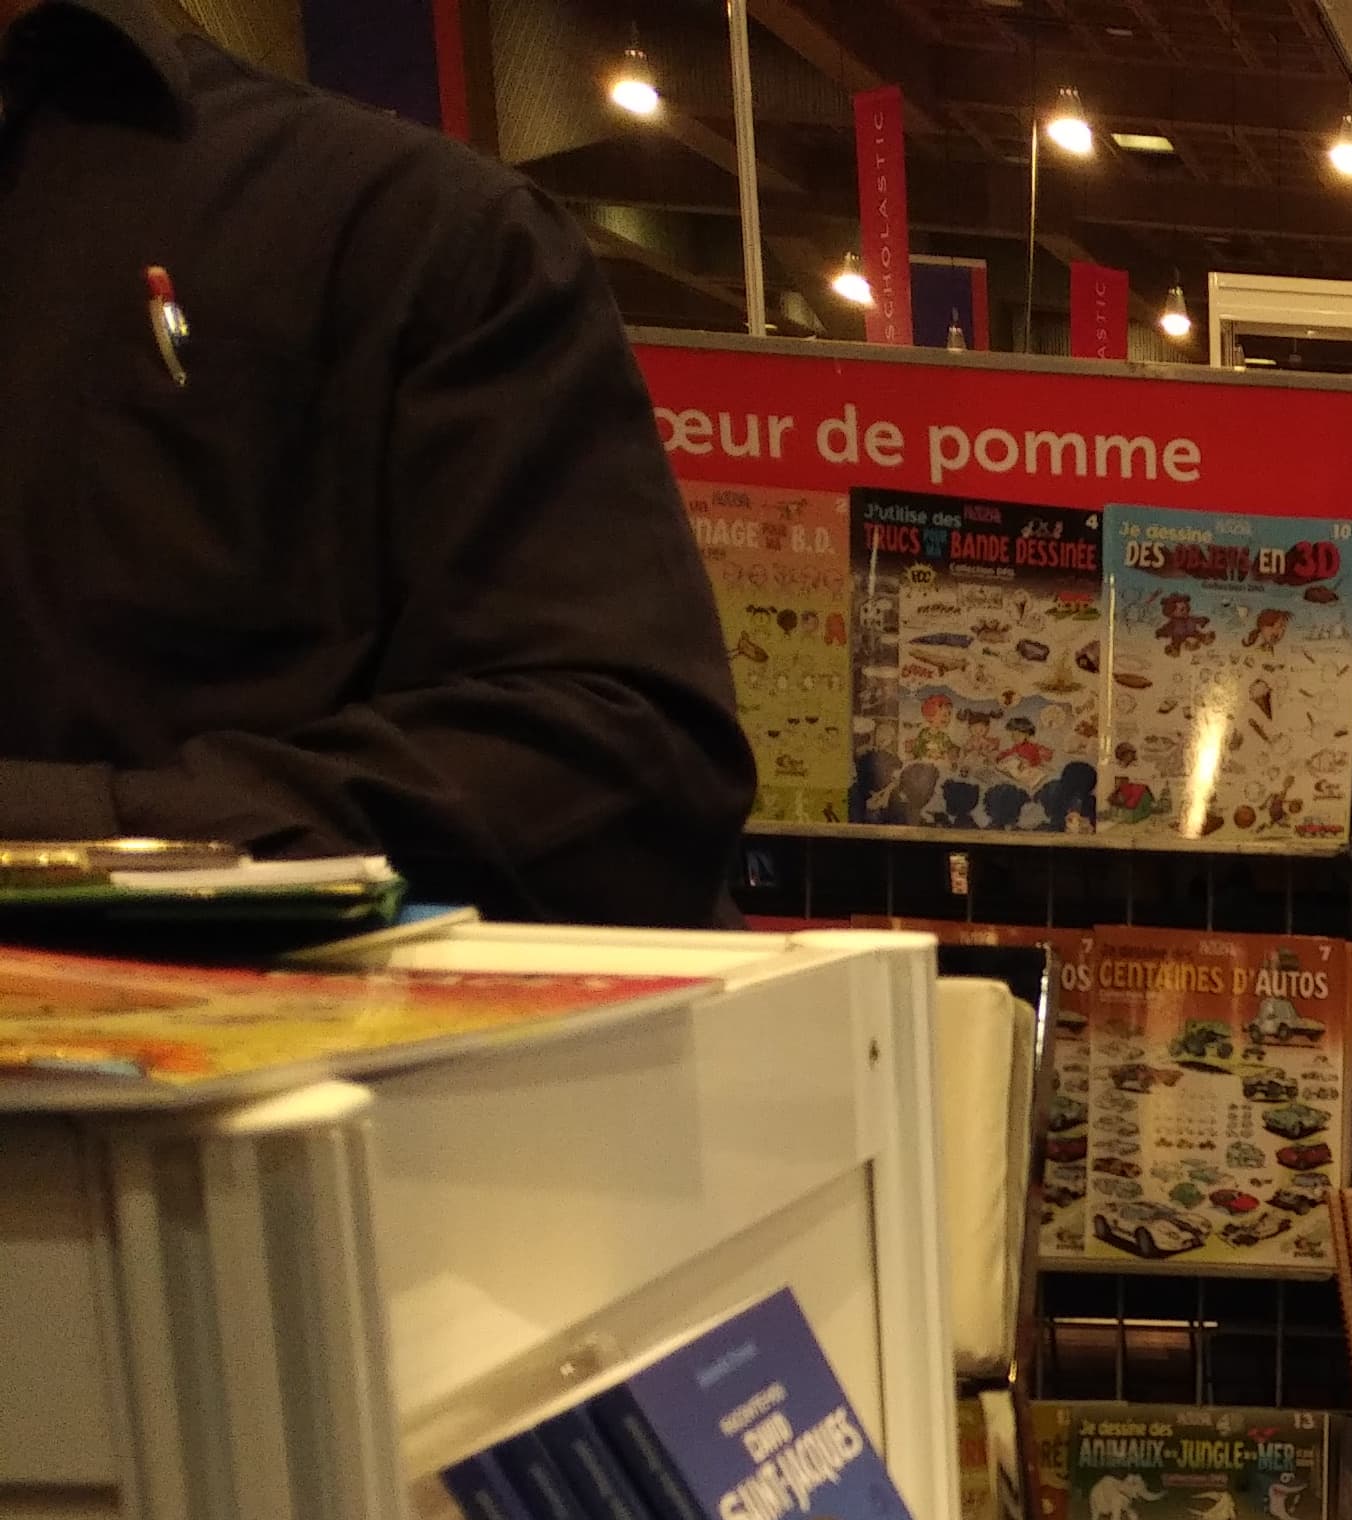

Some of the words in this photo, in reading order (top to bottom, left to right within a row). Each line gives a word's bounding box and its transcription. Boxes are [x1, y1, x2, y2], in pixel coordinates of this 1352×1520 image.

[873, 111, 897, 341] SCHOLASTIC
[653, 407, 795, 459] œur
[816, 403, 905, 468] de
[928, 423, 1202, 485] pomme
[863, 503, 928, 525] J'utilise
[932, 511, 962, 528] des
[1085, 513, 1099, 531] 4
[691, 516, 760, 549] NAGE
[864, 522, 921, 555] TRUCS
[950, 530, 1010, 564] BANDE
[1015, 536, 1098, 572] DESSINÉE
[1119, 520, 1141, 538] Je
[1146, 525, 1216, 545] dessine
[1124, 541, 1166, 569] DES
[1258, 548, 1287, 576] EN
[1292, 541, 1342, 578] 3D
[1317, 944, 1332, 962] 7
[1100, 958, 1224, 995] CENTAINES
[1231, 967, 1330, 1000] D'AUTOS
[1080, 1419, 1096, 1436] Je
[1098, 1420, 1147, 1437] dessine
[1149, 1421, 1174, 1438] des
[1079, 1438, 1165, 1468] ANIMAUX
[1175, 1440, 1245, 1470] JUNGLE
[1257, 1442, 1296, 1471] MER
